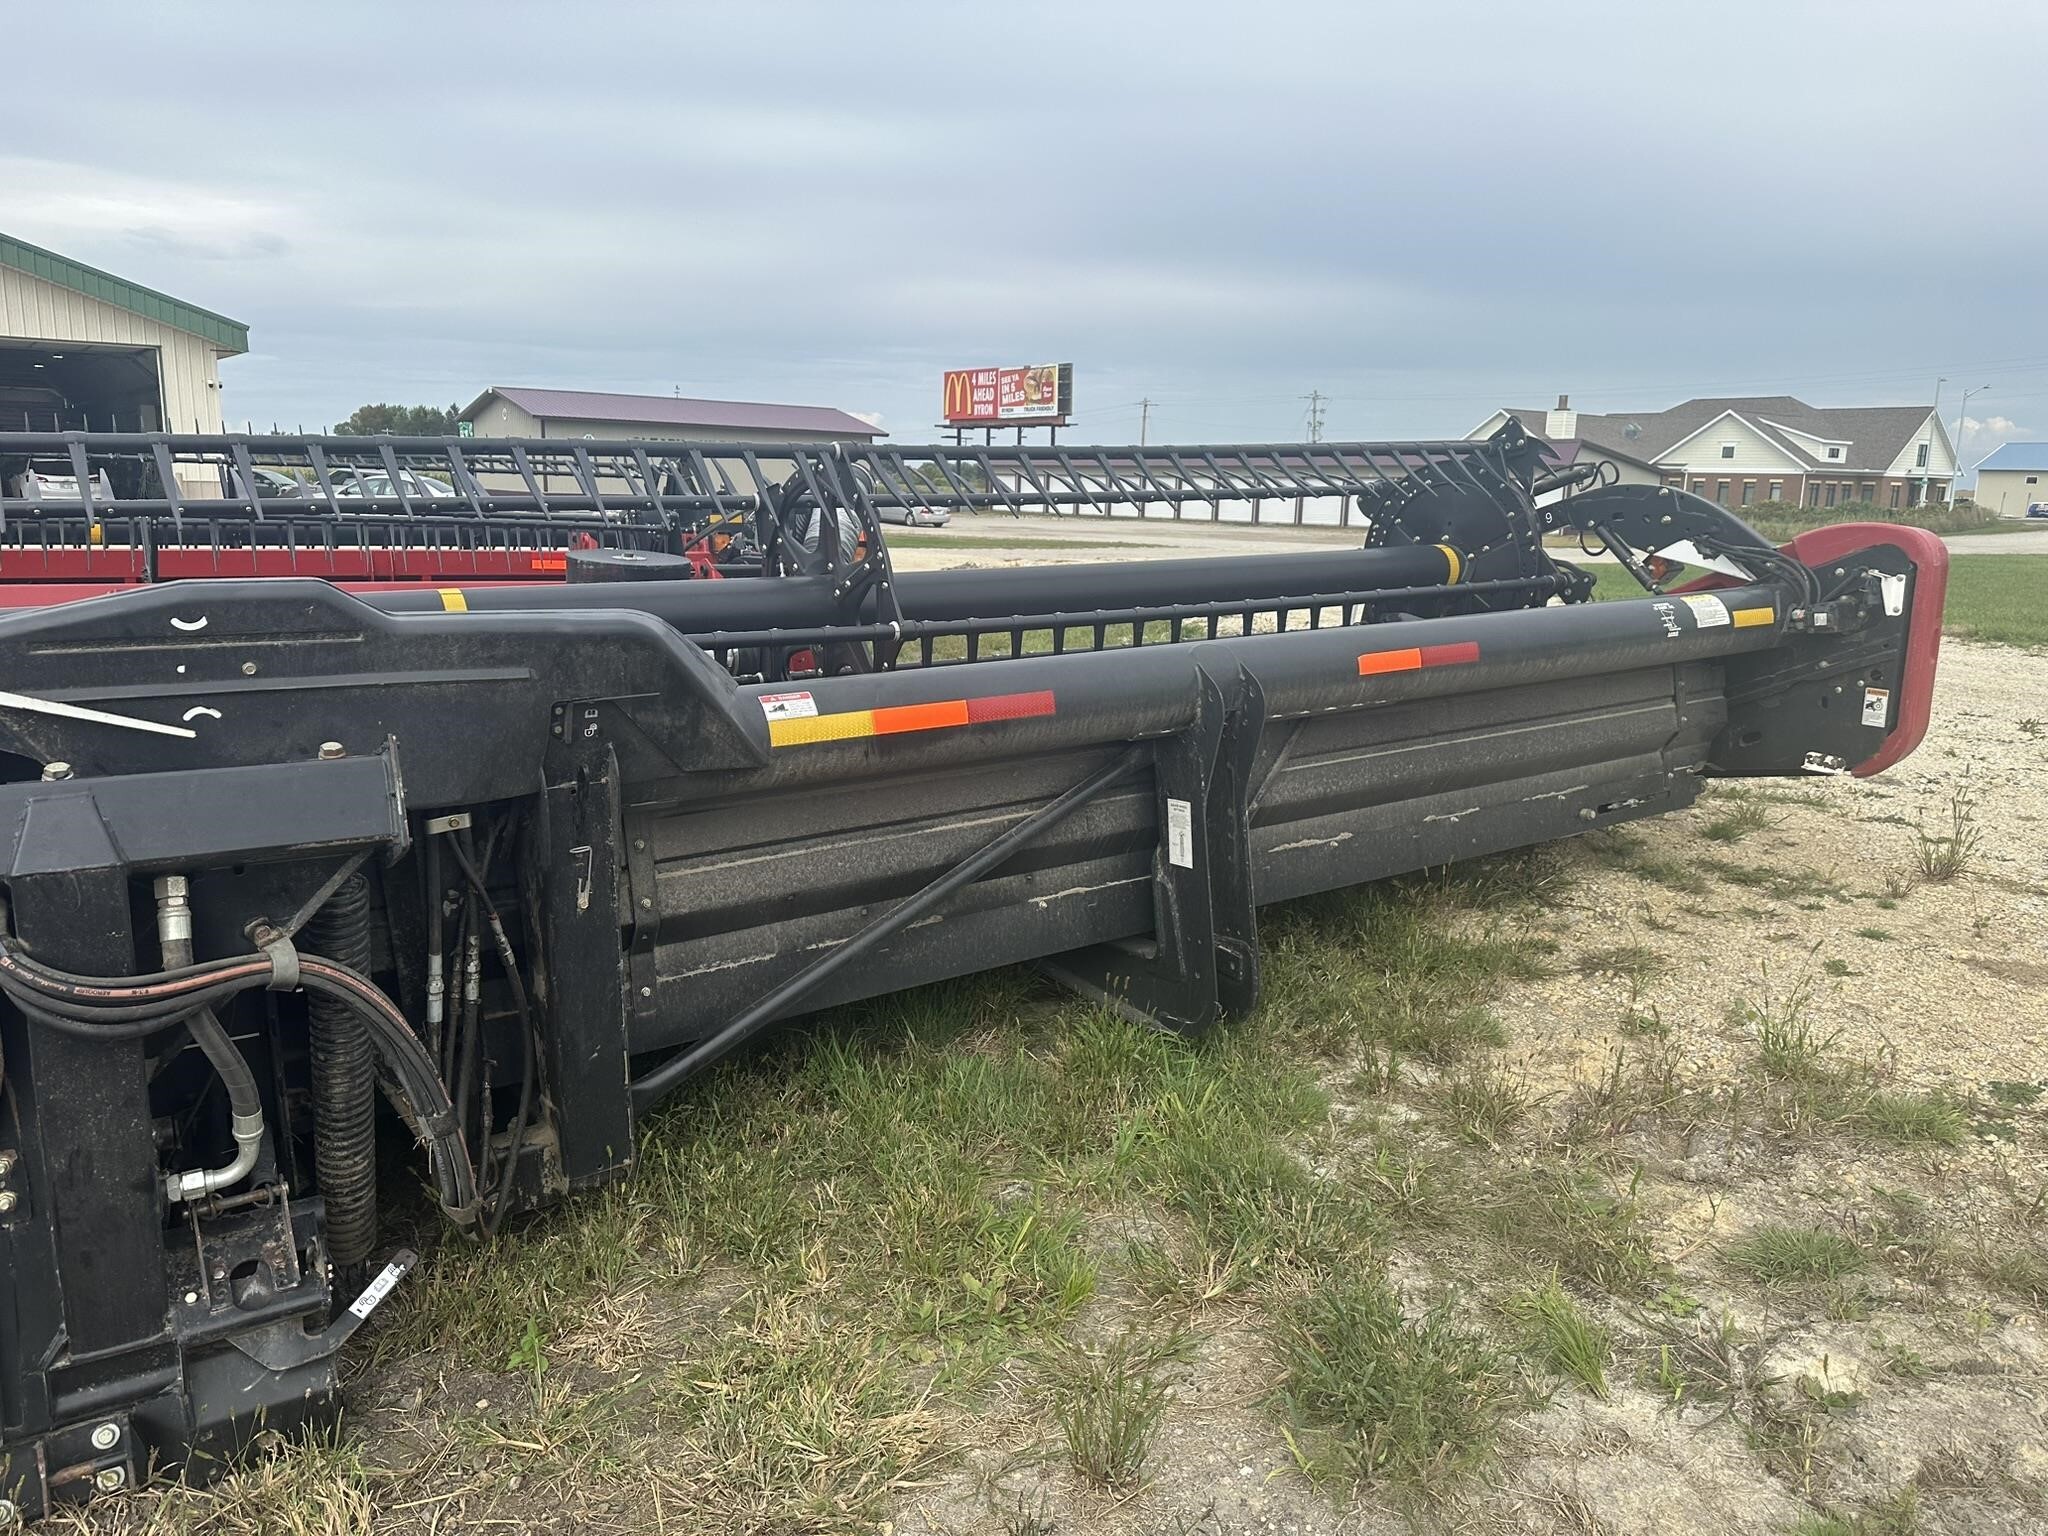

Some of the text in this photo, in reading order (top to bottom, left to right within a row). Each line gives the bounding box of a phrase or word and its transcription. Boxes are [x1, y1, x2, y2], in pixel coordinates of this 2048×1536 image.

[972, 371, 997, 386] 4 MILES
[1001, 373, 1020, 384] SEE YA
[973, 387, 994, 402] AHEAD
[1002, 384, 1010, 394] IN
[1002, 391, 1025, 405] MILES
[973, 403, 994, 416] BYRON
[1545, 512, 1553, 524] 9
